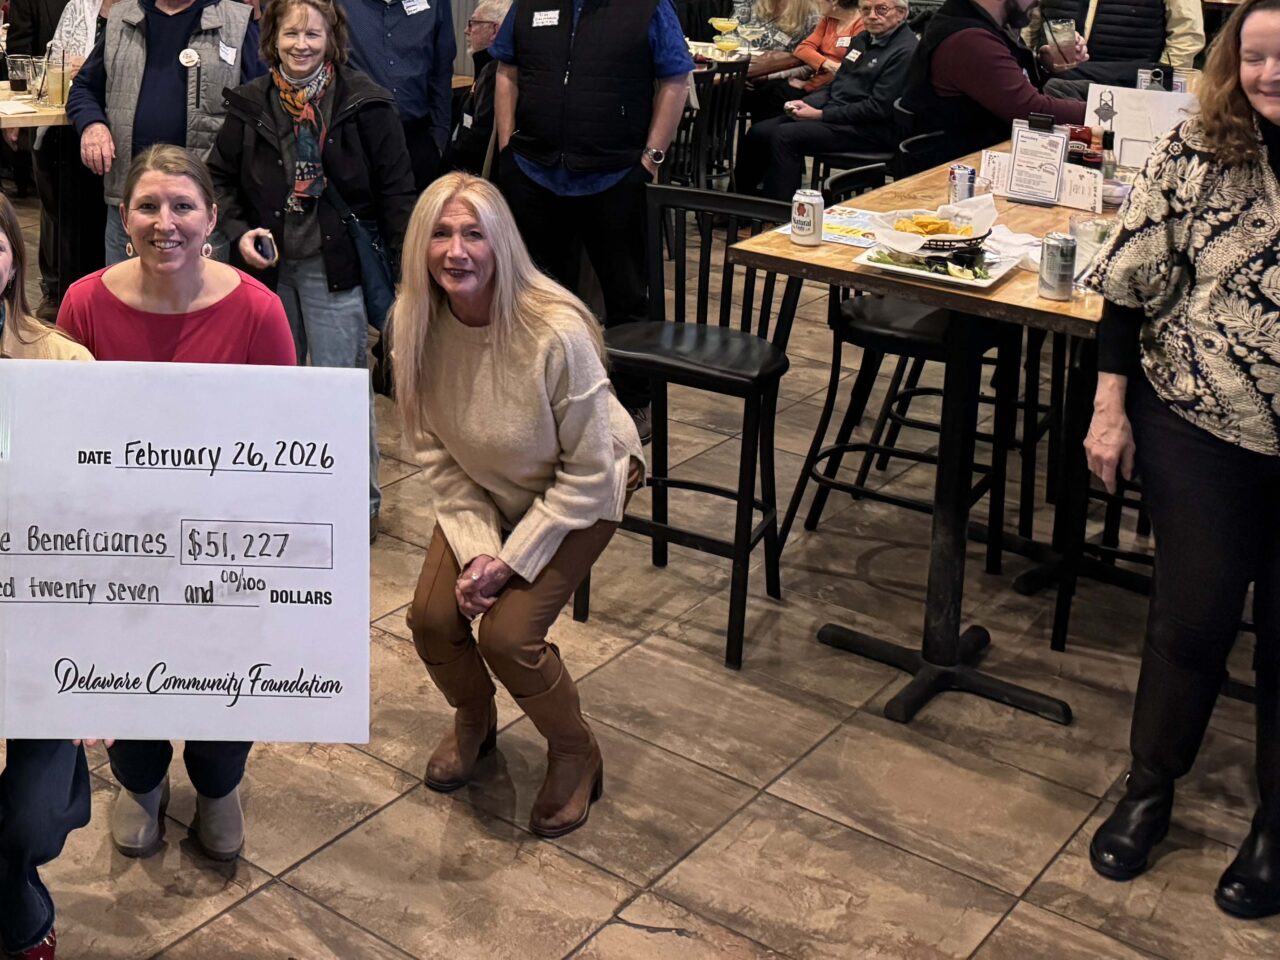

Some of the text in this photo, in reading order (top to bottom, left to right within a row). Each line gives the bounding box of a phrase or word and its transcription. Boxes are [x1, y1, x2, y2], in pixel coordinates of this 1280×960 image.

[78, 450, 111, 465] DATE
[125, 440, 221, 476] February
[188, 528, 290, 561] $51,227
[29, 577, 96, 604] twenty
[106, 581, 159, 602] seven
[185, 581, 213, 603] and
[270, 590, 332, 605] DOLLARS
[54, 658, 343, 707] Delaware Community Foundation
